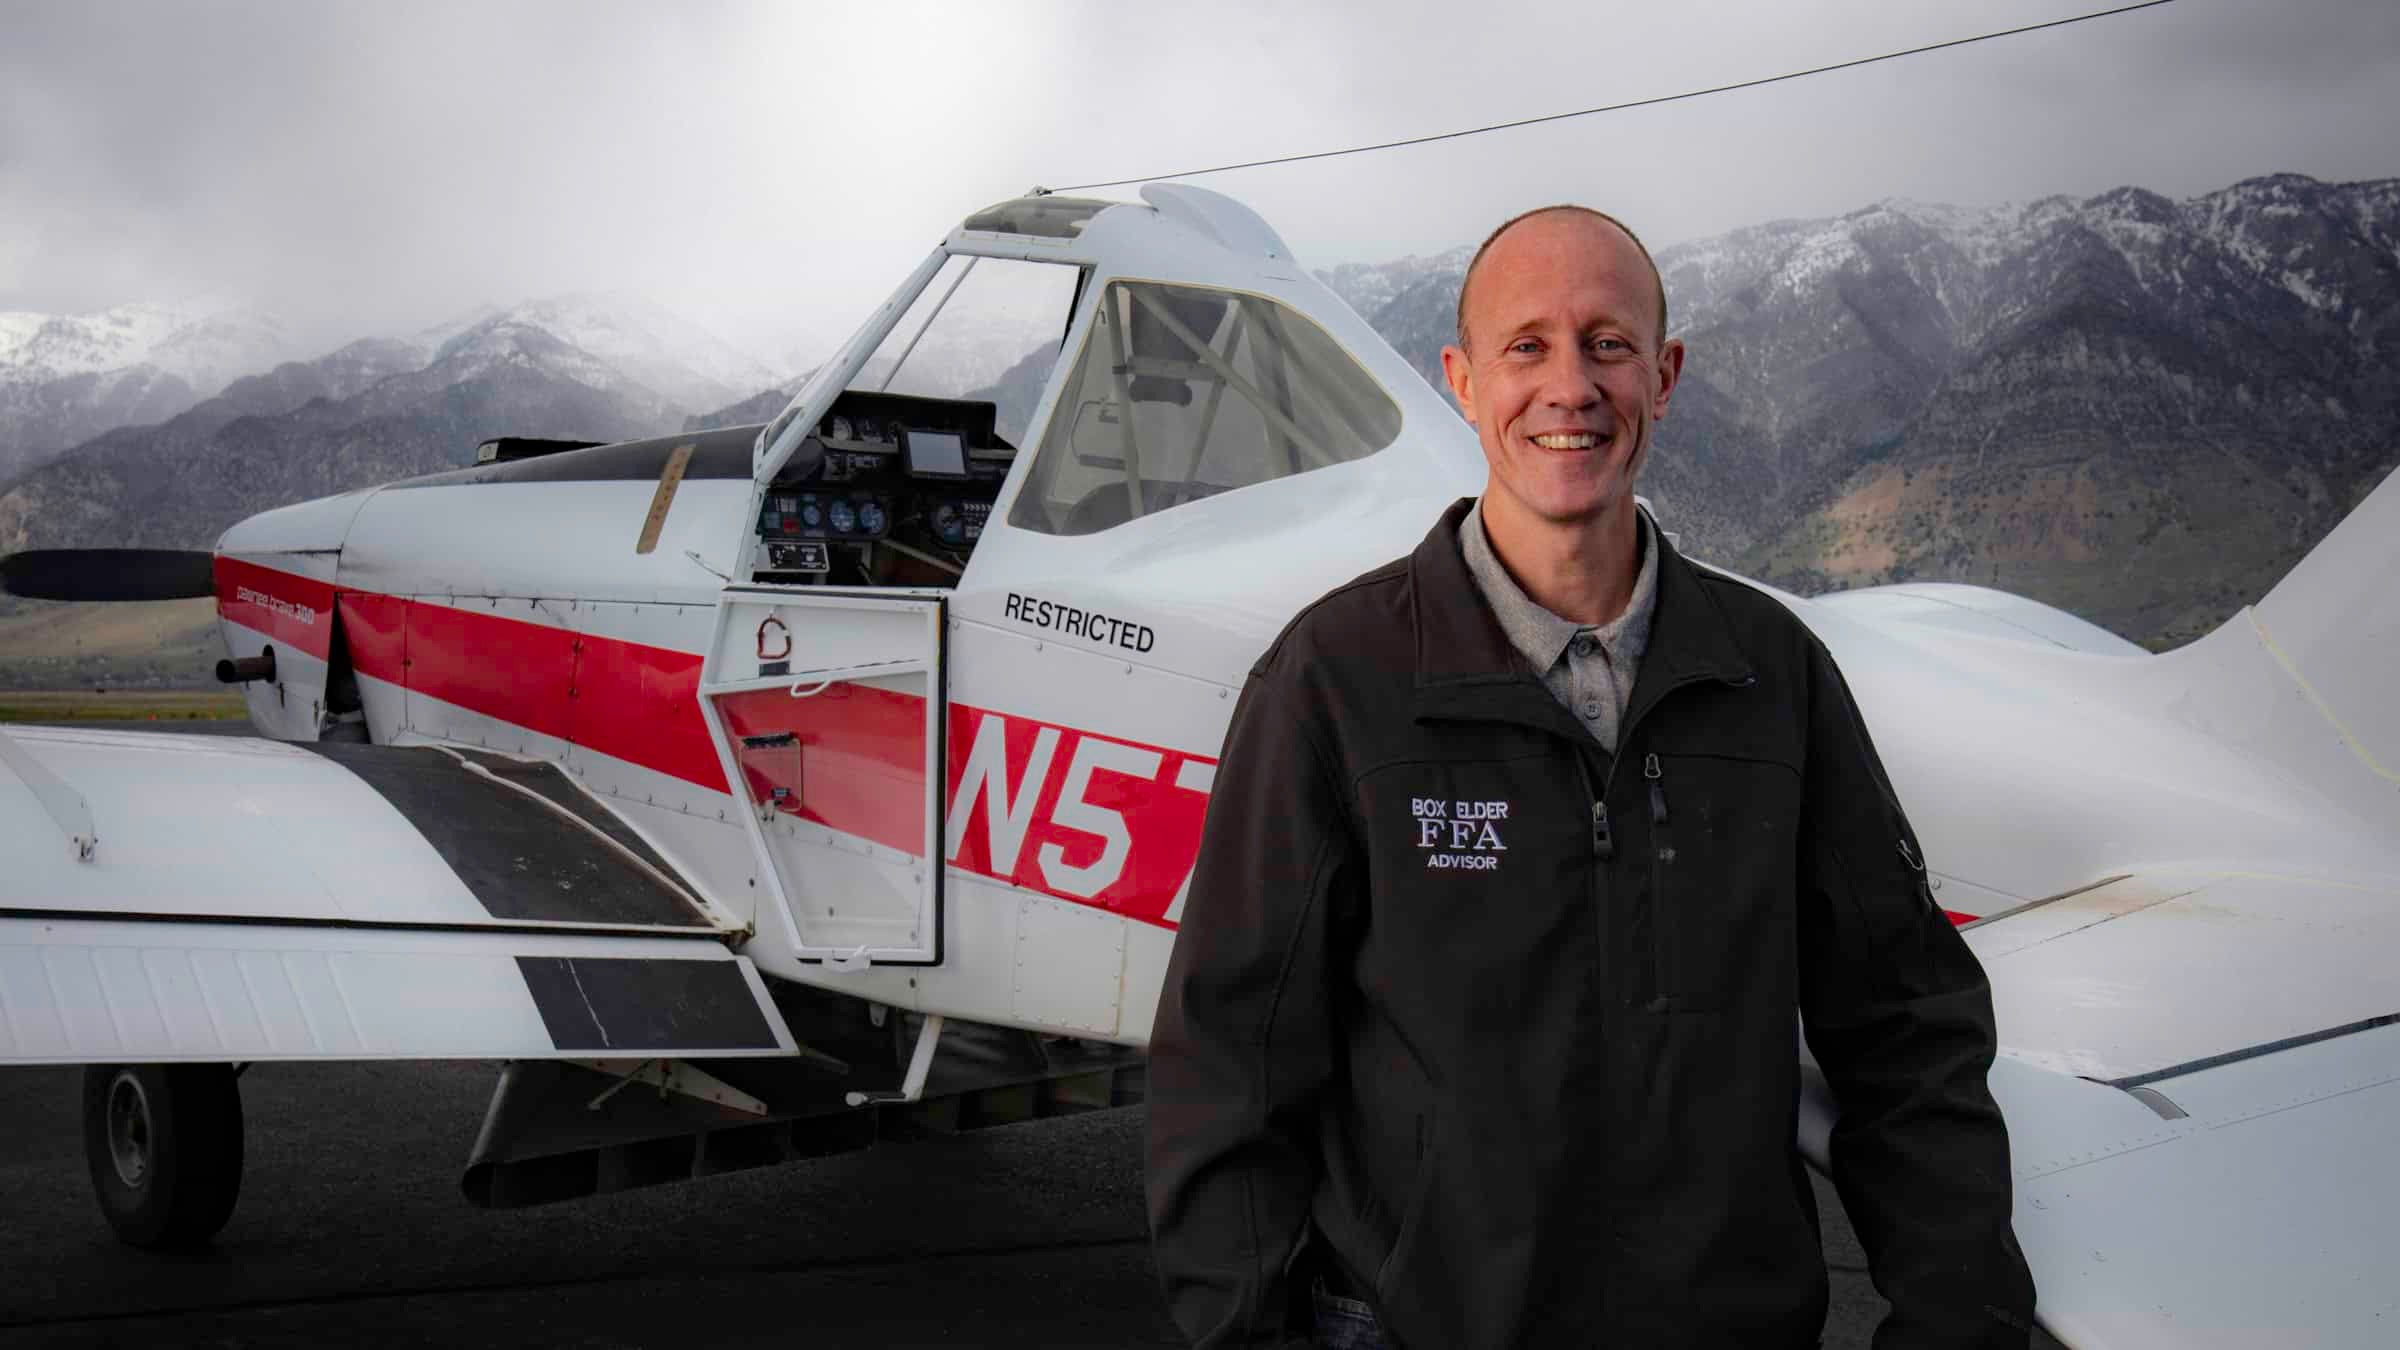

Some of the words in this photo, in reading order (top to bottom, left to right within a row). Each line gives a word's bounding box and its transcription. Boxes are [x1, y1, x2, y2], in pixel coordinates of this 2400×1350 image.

[1004, 592, 1155, 653] RESTRICTED
[1411, 798, 1447, 817] BOX
[1455, 801, 1509, 819] ELDER
[1417, 818, 1508, 850] FFA
[1427, 854, 1498, 870] ADVISOR
